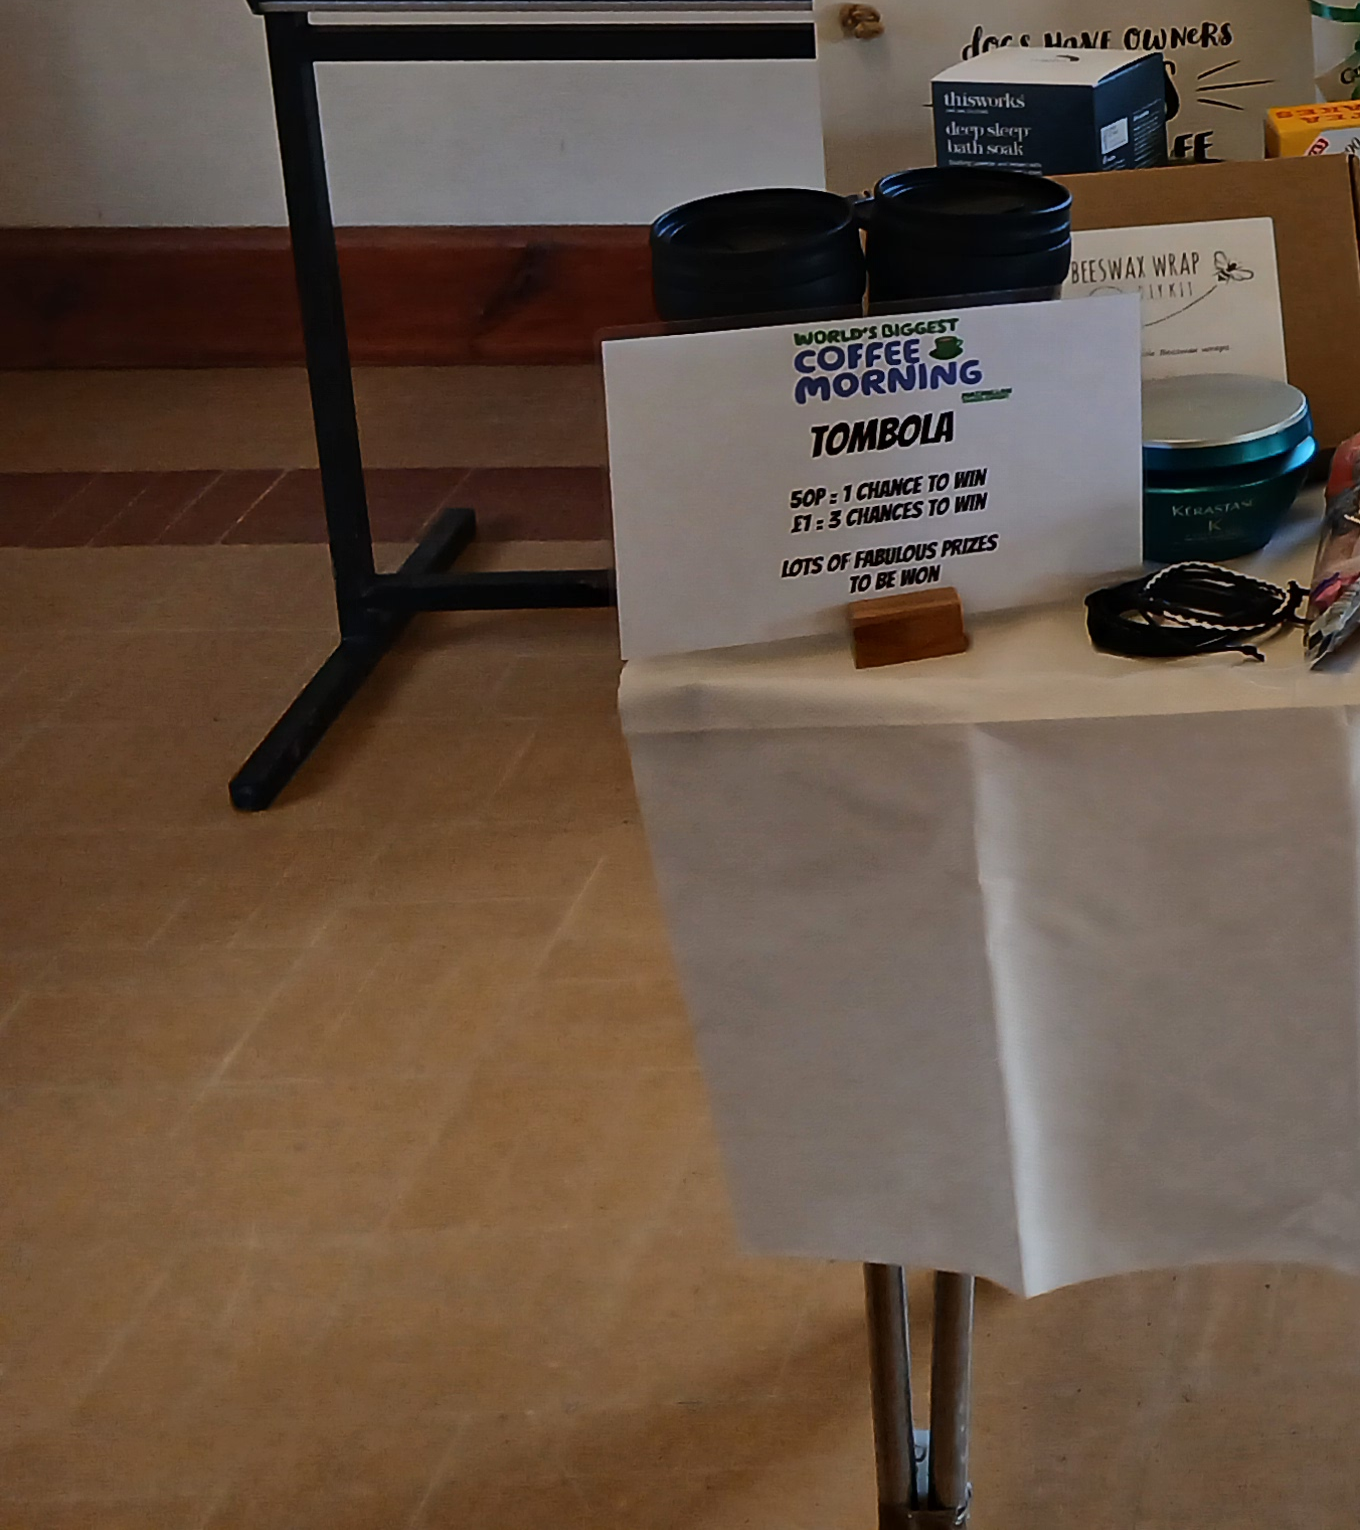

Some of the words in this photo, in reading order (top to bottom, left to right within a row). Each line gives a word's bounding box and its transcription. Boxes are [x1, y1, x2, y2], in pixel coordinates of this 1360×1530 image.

[944, 91, 1026, 109] thisworks
[946, 120, 985, 141] deep
[986, 119, 1032, 141] sleep
[947, 139, 983, 156] bath
[986, 141, 1023, 157] soak
[1071, 256, 1145, 284] BEESWAX
[1153, 251, 1200, 277] WRAP
[793, 325, 878, 346] WORLD'S
[882, 317, 960, 339] BIGGEST
[793, 338, 921, 374] COFFEE
[794, 359, 983, 405] MORNING
[810, 410, 955, 458] TOMBOLA
[790, 487, 827, 509] 50P
[843, 484, 853, 503] 1
[856, 475, 924, 502] CHANCE
[928, 472, 950, 493] TO
[953, 468, 988, 490] WIN
[790, 514, 813, 534] £1
[828, 510, 842, 530] 3
[846, 500, 924, 527] CHANCES
[928, 497, 951, 517] TO
[953, 492, 989, 514] WIN
[781, 556, 825, 579] LOTS
[827, 552, 852, 573] OF
[853, 541, 939, 570] FABULOUS
[940, 533, 1000, 559] PRIZES
[849, 573, 872, 594] TO
[875, 571, 896, 591] BE
[899, 565, 941, 588] WON
